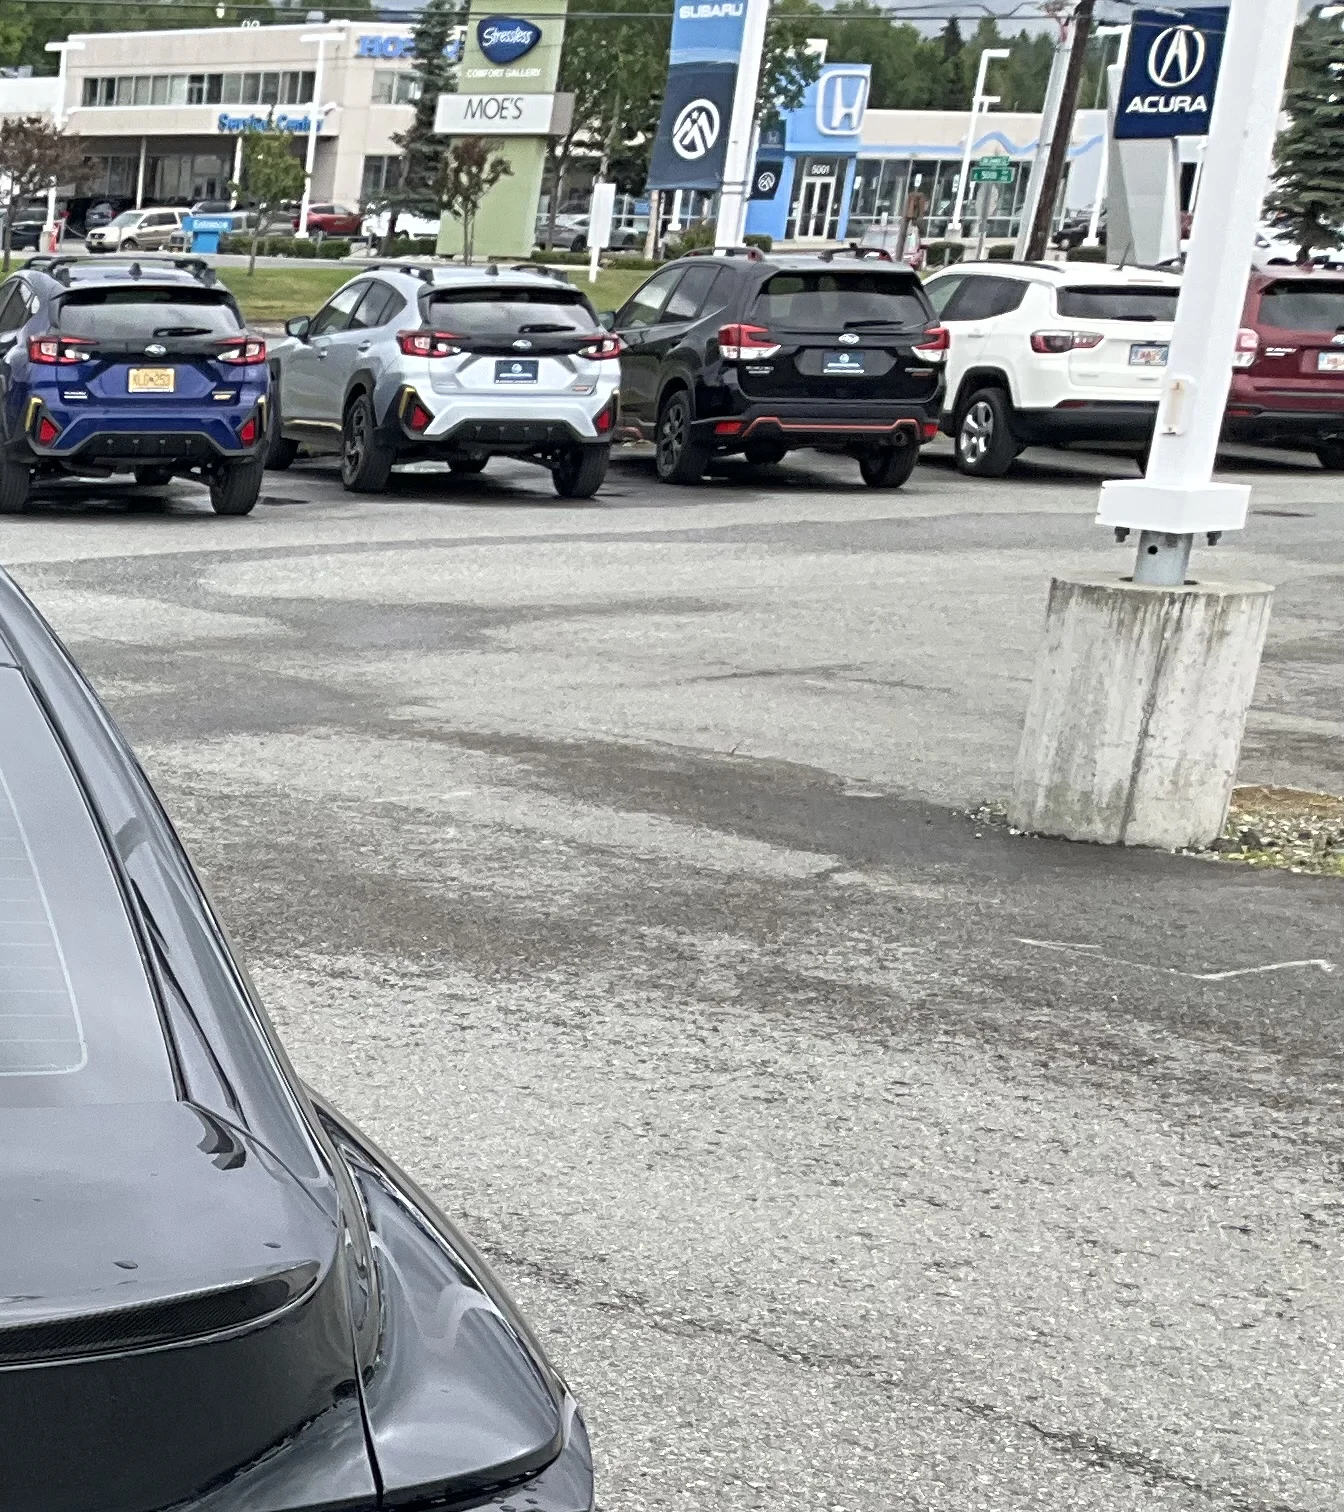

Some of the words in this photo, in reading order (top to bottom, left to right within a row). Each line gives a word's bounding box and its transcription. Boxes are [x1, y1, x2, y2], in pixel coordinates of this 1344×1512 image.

[679, 3, 743, 18] SUBARU
[482, 26, 533, 47] Stressless
[467, 68, 504, 78] COMFORT
[505, 68, 541, 77] GALLERY
[464, 98, 524, 120] MOE'S
[1125, 95, 1208, 114] ACURA
